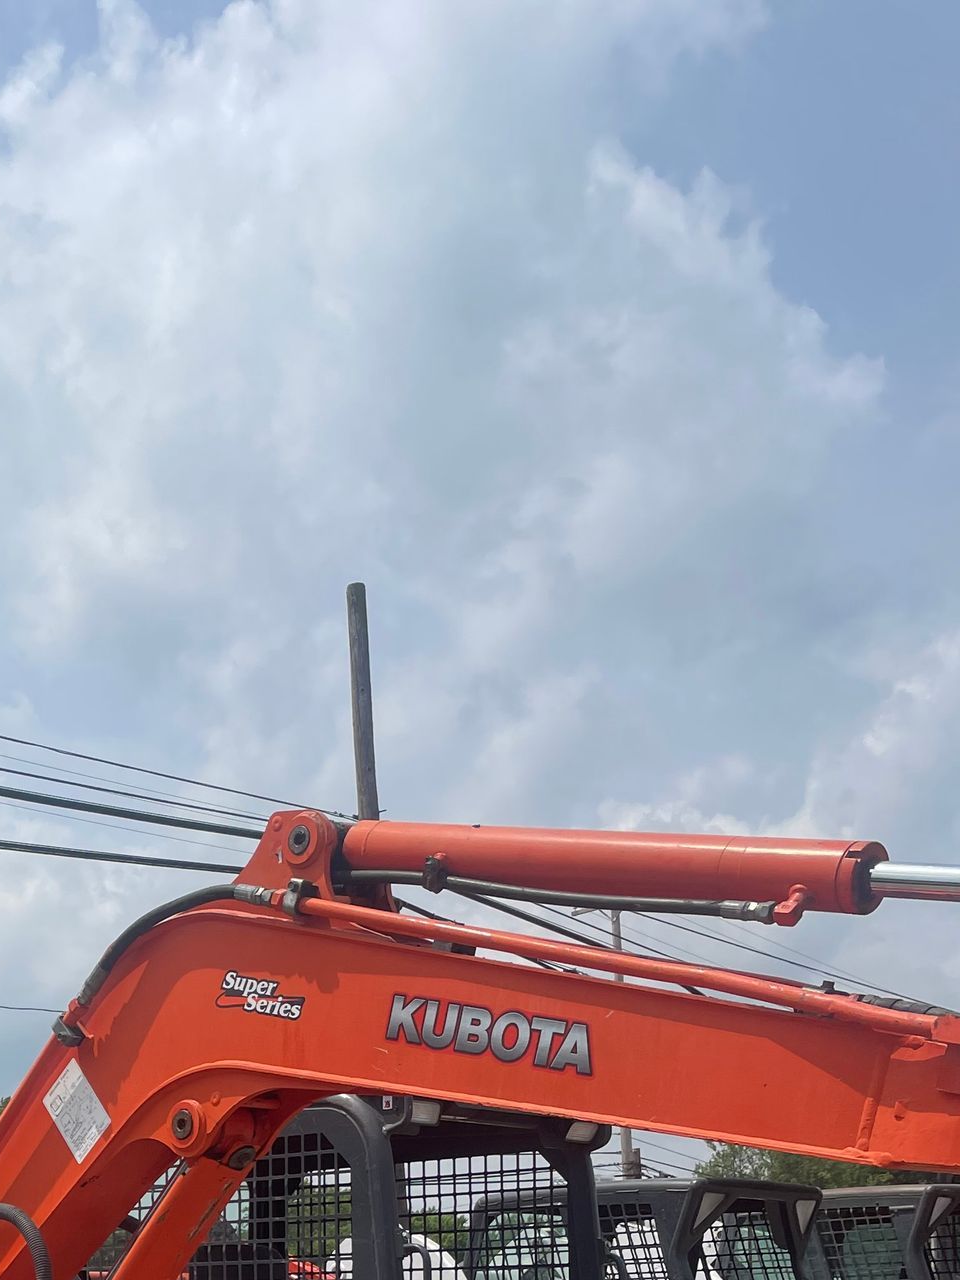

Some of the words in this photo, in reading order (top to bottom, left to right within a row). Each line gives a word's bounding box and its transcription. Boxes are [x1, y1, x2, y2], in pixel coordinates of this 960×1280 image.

[222, 970, 278, 997] Super
[243, 993, 302, 1019] Series
[386, 994, 593, 1076] KUBOTA
